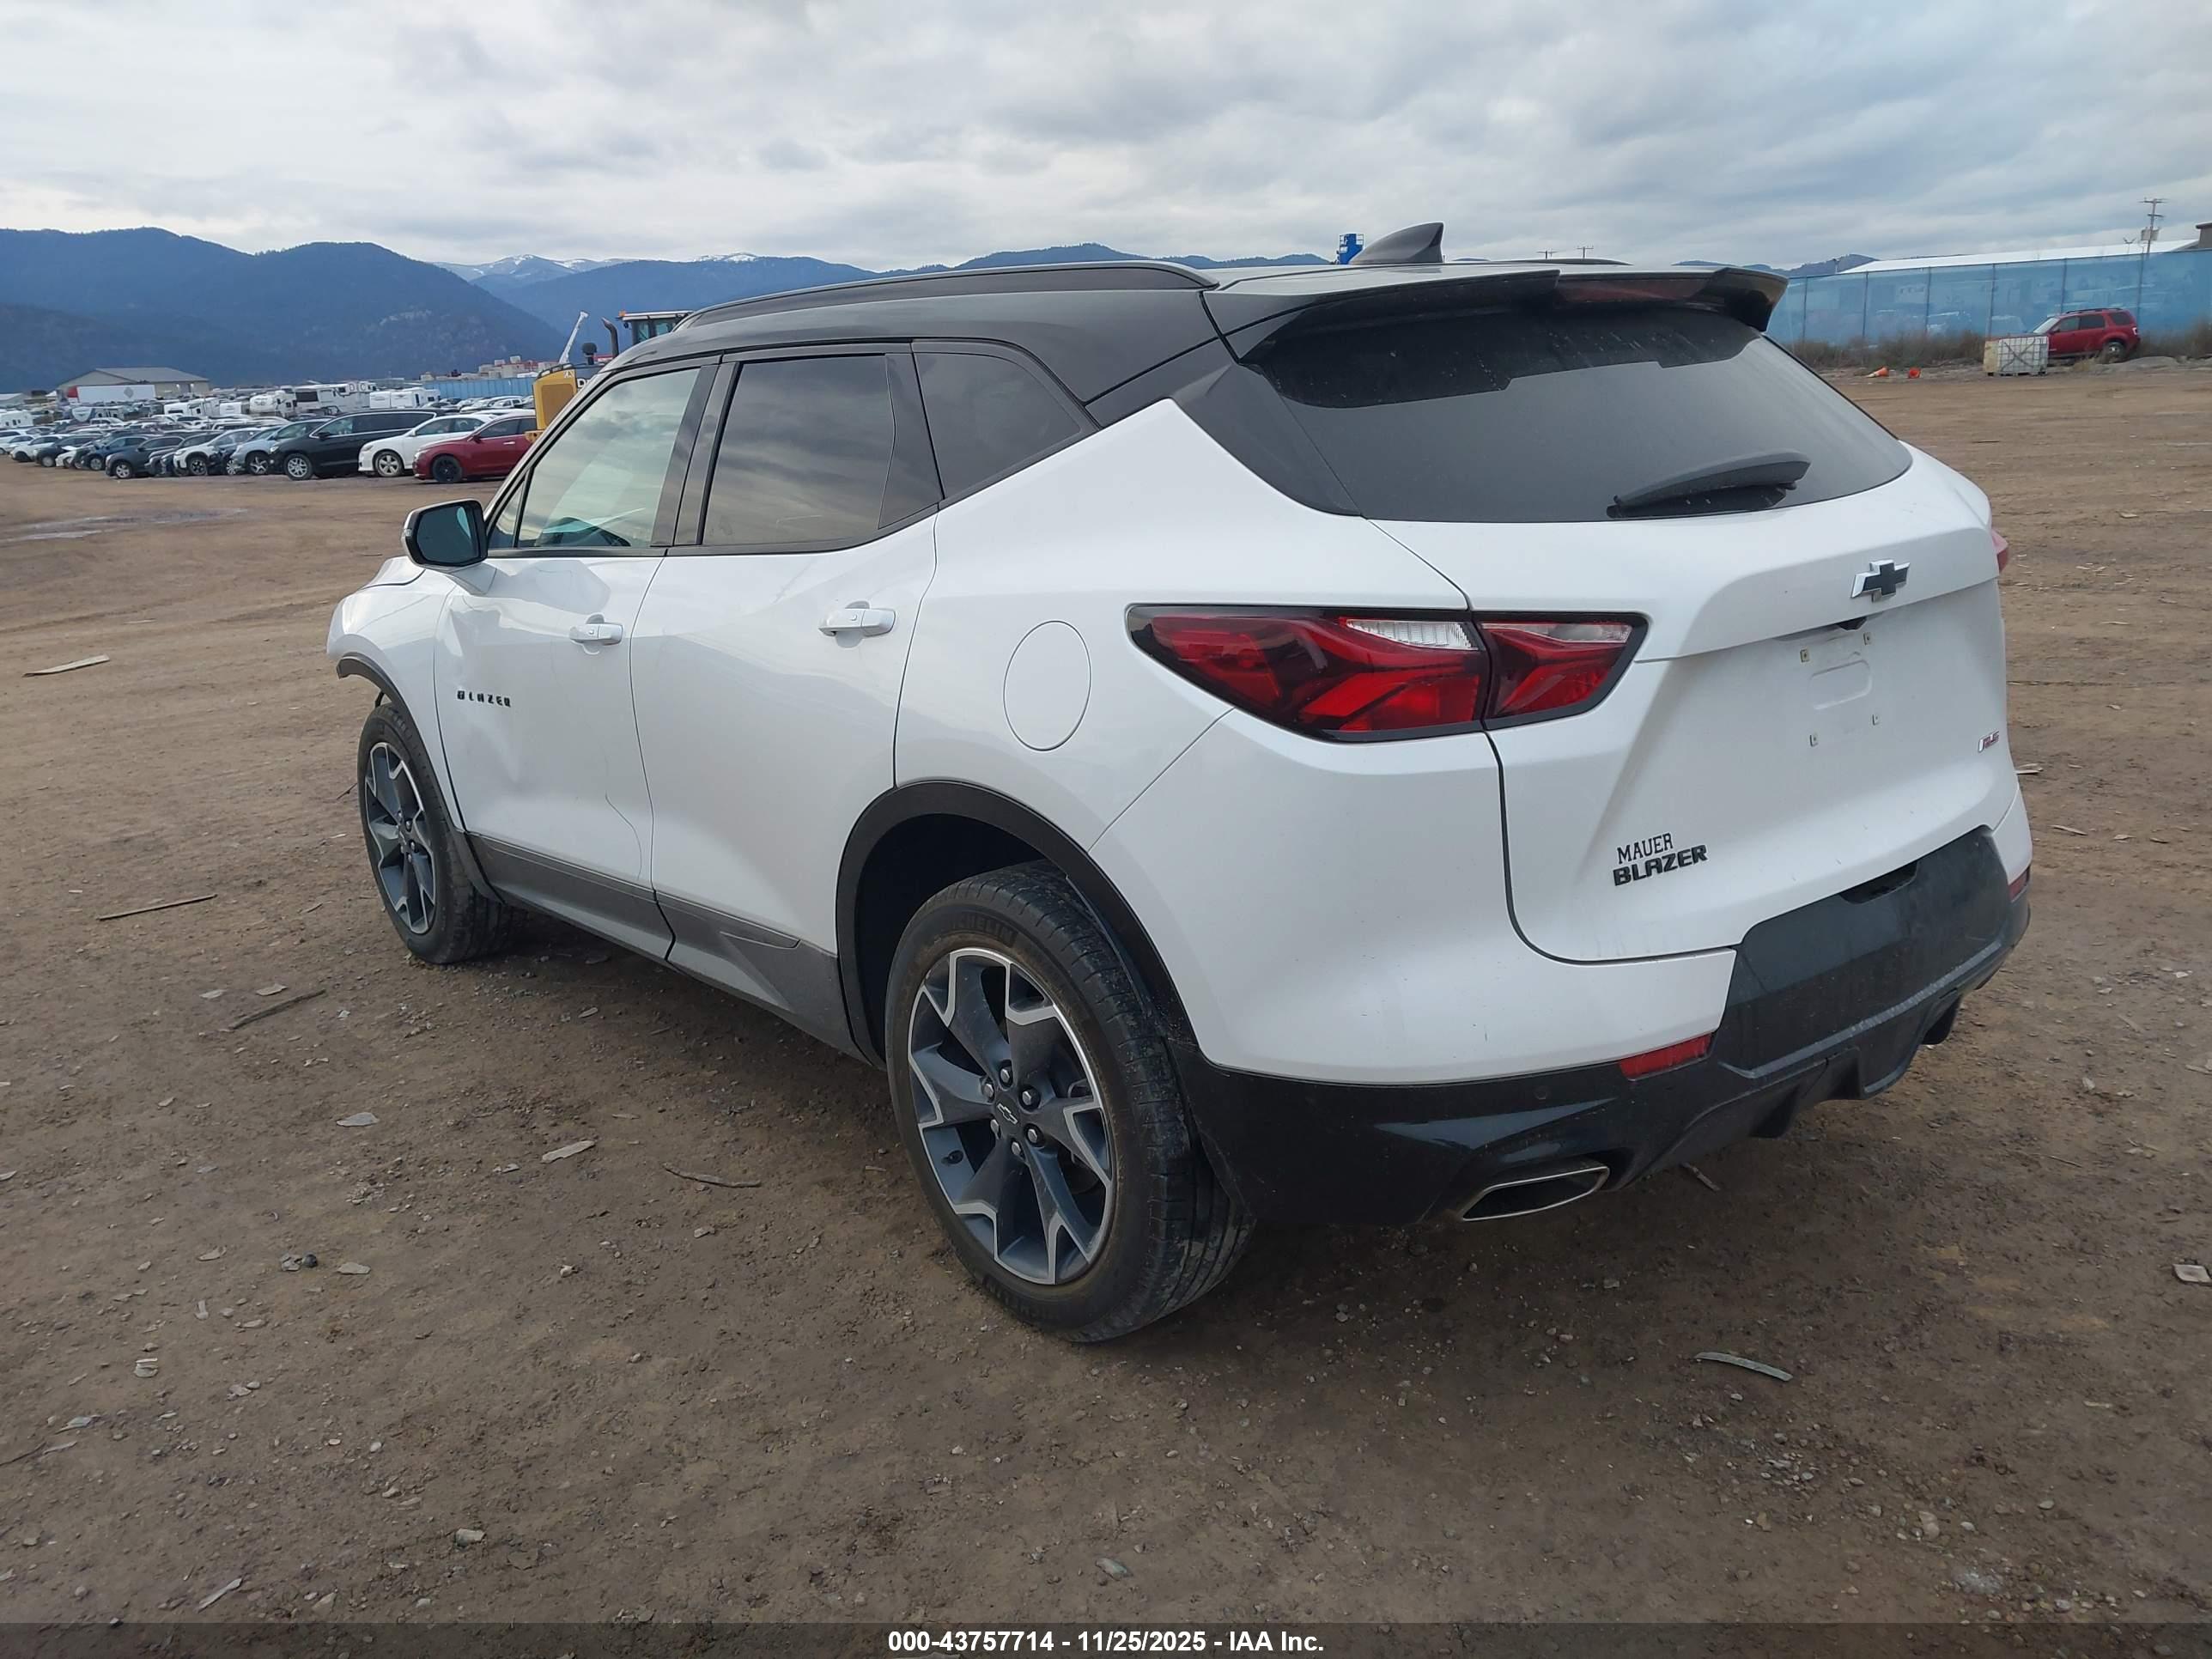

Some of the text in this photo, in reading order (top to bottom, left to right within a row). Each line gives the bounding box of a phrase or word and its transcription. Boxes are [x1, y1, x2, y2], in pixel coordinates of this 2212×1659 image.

[457, 690, 511, 708] BLAZER
[1617, 832, 1674, 864] MAUER
[1613, 844, 1709, 886] BLAZER
